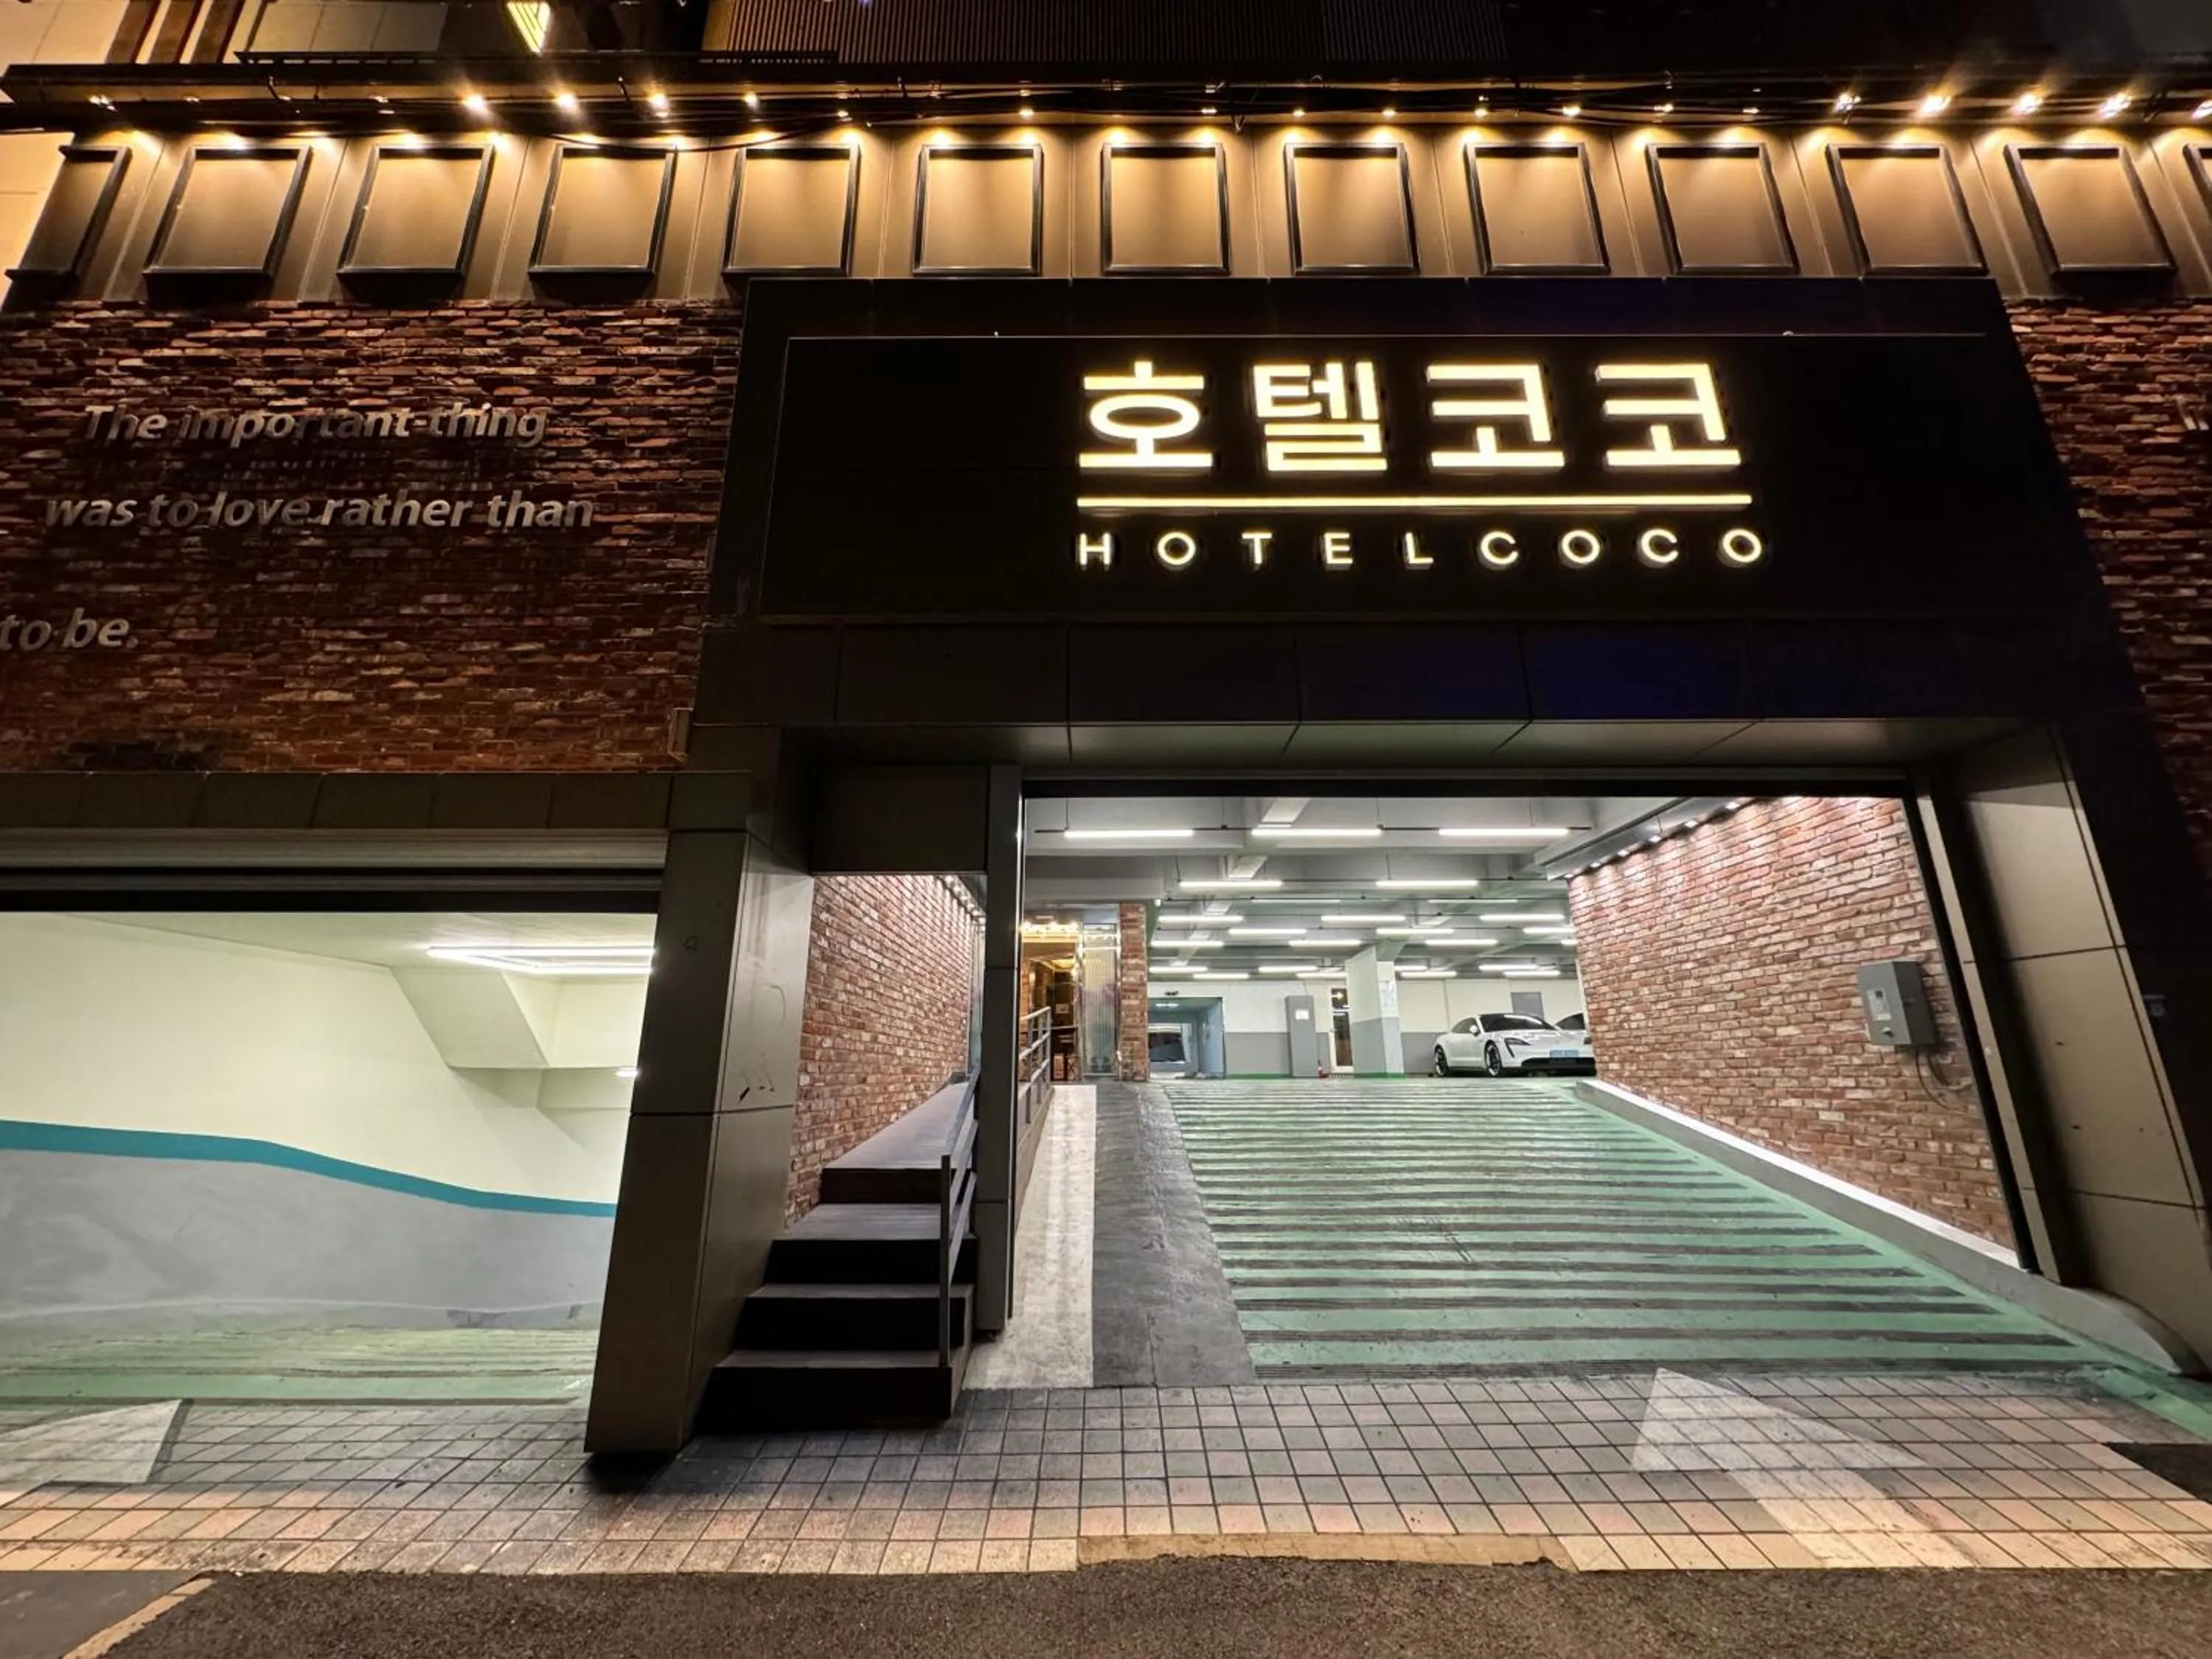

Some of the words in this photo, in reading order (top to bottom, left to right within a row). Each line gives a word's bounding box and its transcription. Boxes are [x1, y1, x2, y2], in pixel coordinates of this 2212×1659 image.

[84, 404, 168, 440] The
[179, 405, 414, 448] important
[431, 403, 548, 448] thing
[1079, 361, 1742, 472] 호텔코코
[44, 498, 138, 527] was
[148, 493, 198, 527] to
[207, 491, 311, 527] love
[320, 489, 473, 527] rather
[487, 490, 593, 528] than
[0, 614, 52, 650] to
[62, 607, 139, 650] be.
